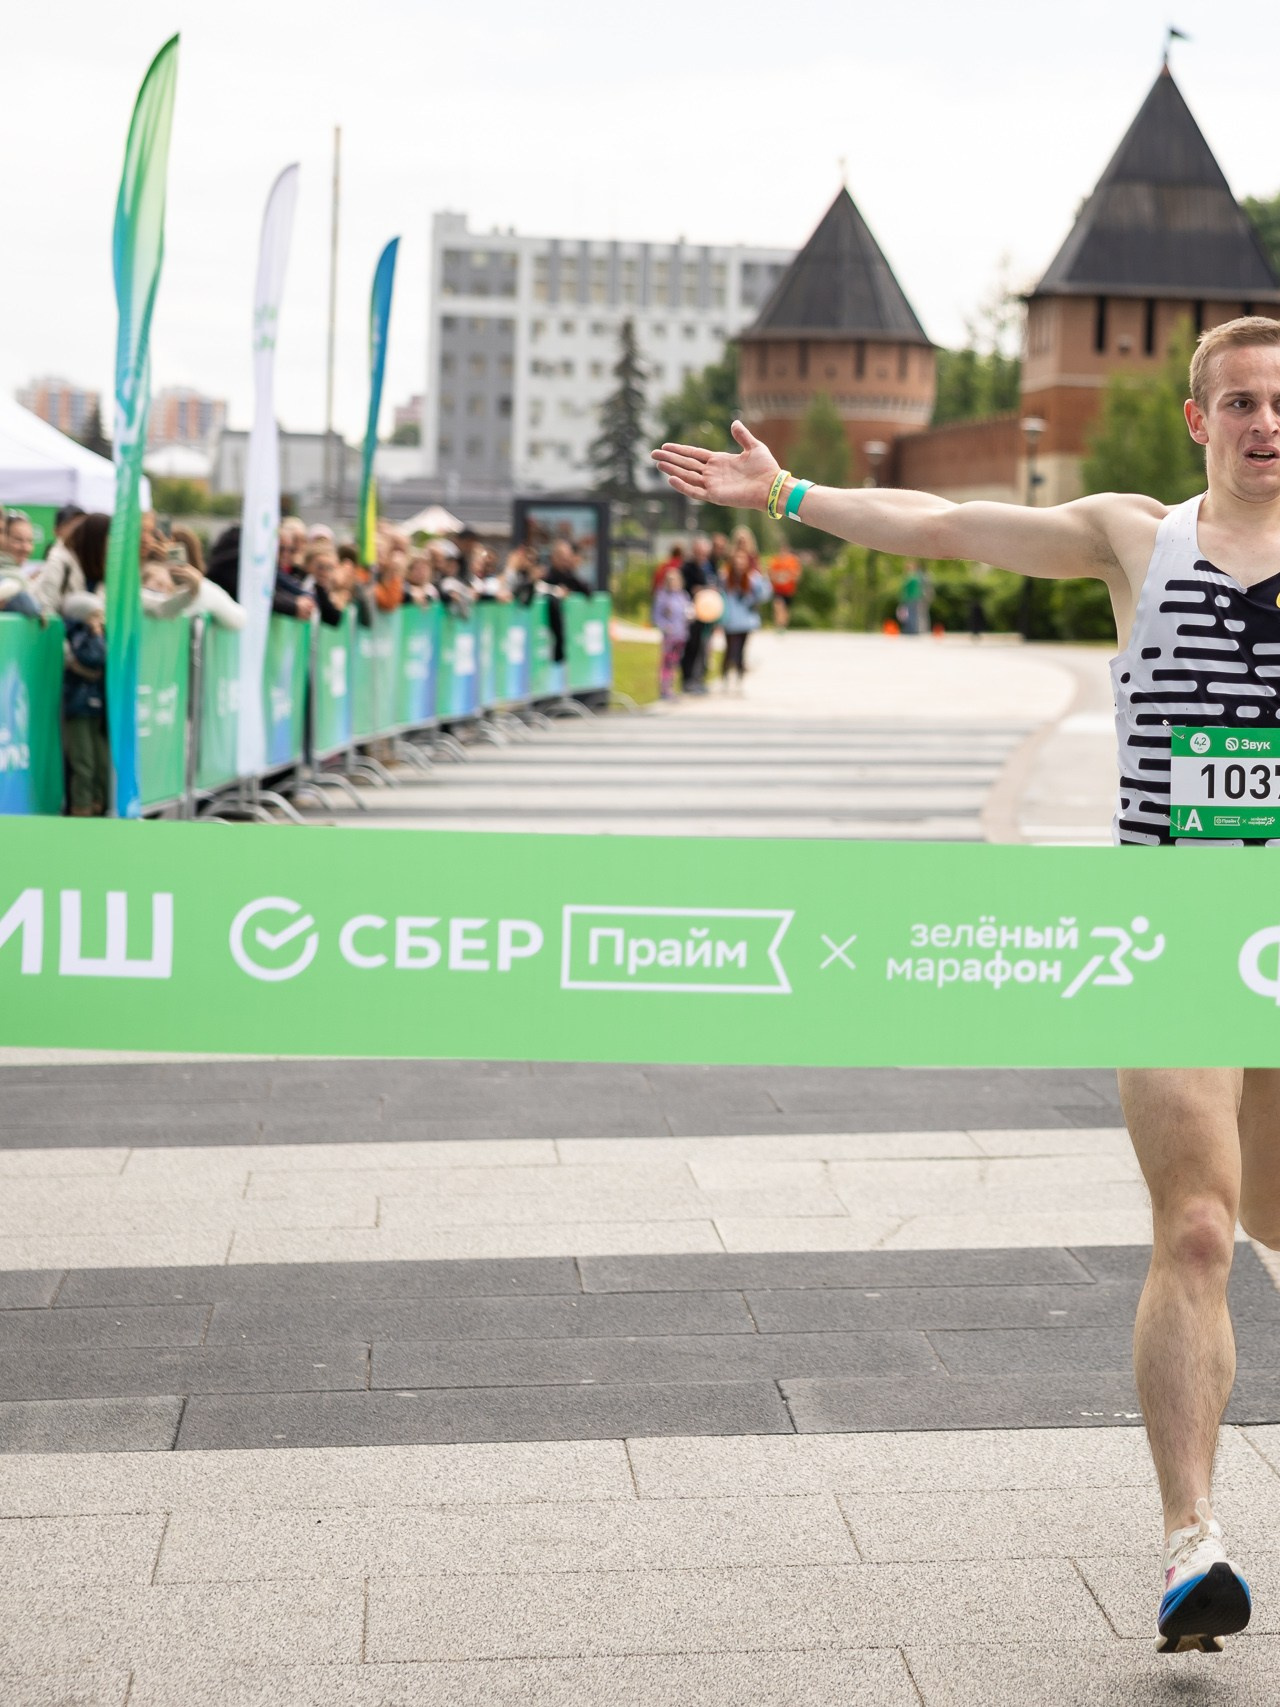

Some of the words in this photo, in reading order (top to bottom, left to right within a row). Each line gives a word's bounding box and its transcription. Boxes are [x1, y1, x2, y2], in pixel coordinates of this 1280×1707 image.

[1241, 738, 1271, 752] Звук
[339, 914, 544, 972] СБЕР
[588, 928, 748, 975] Прайм
[910, 915, 1079, 949] зелёный
[886, 950, 1062, 990] марафон
